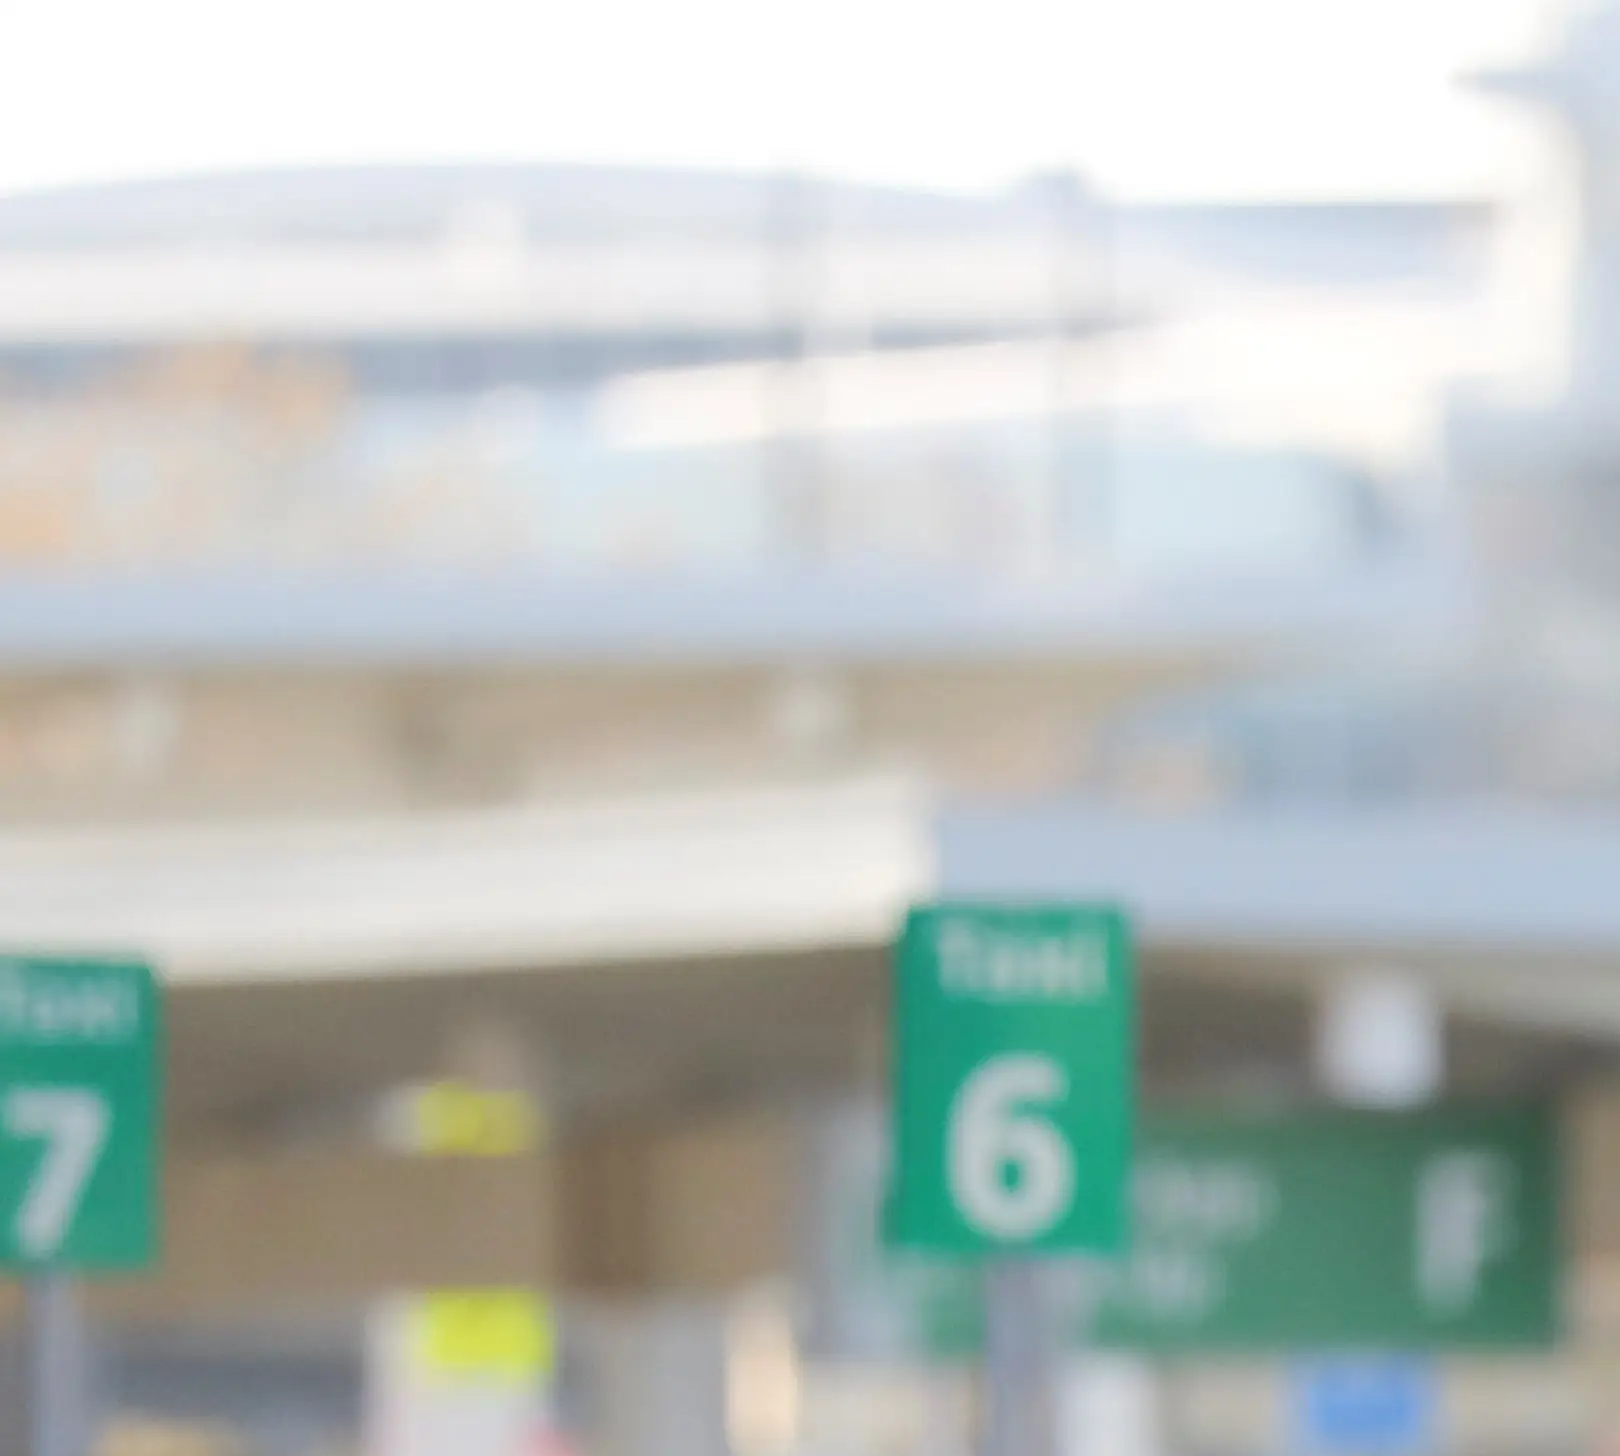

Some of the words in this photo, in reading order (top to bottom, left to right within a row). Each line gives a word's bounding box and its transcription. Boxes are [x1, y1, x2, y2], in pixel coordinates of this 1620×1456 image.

[935, 916, 1108, 999] Taxi
[4, 1085, 113, 1257] 7
[946, 1052, 1076, 1240] 6
